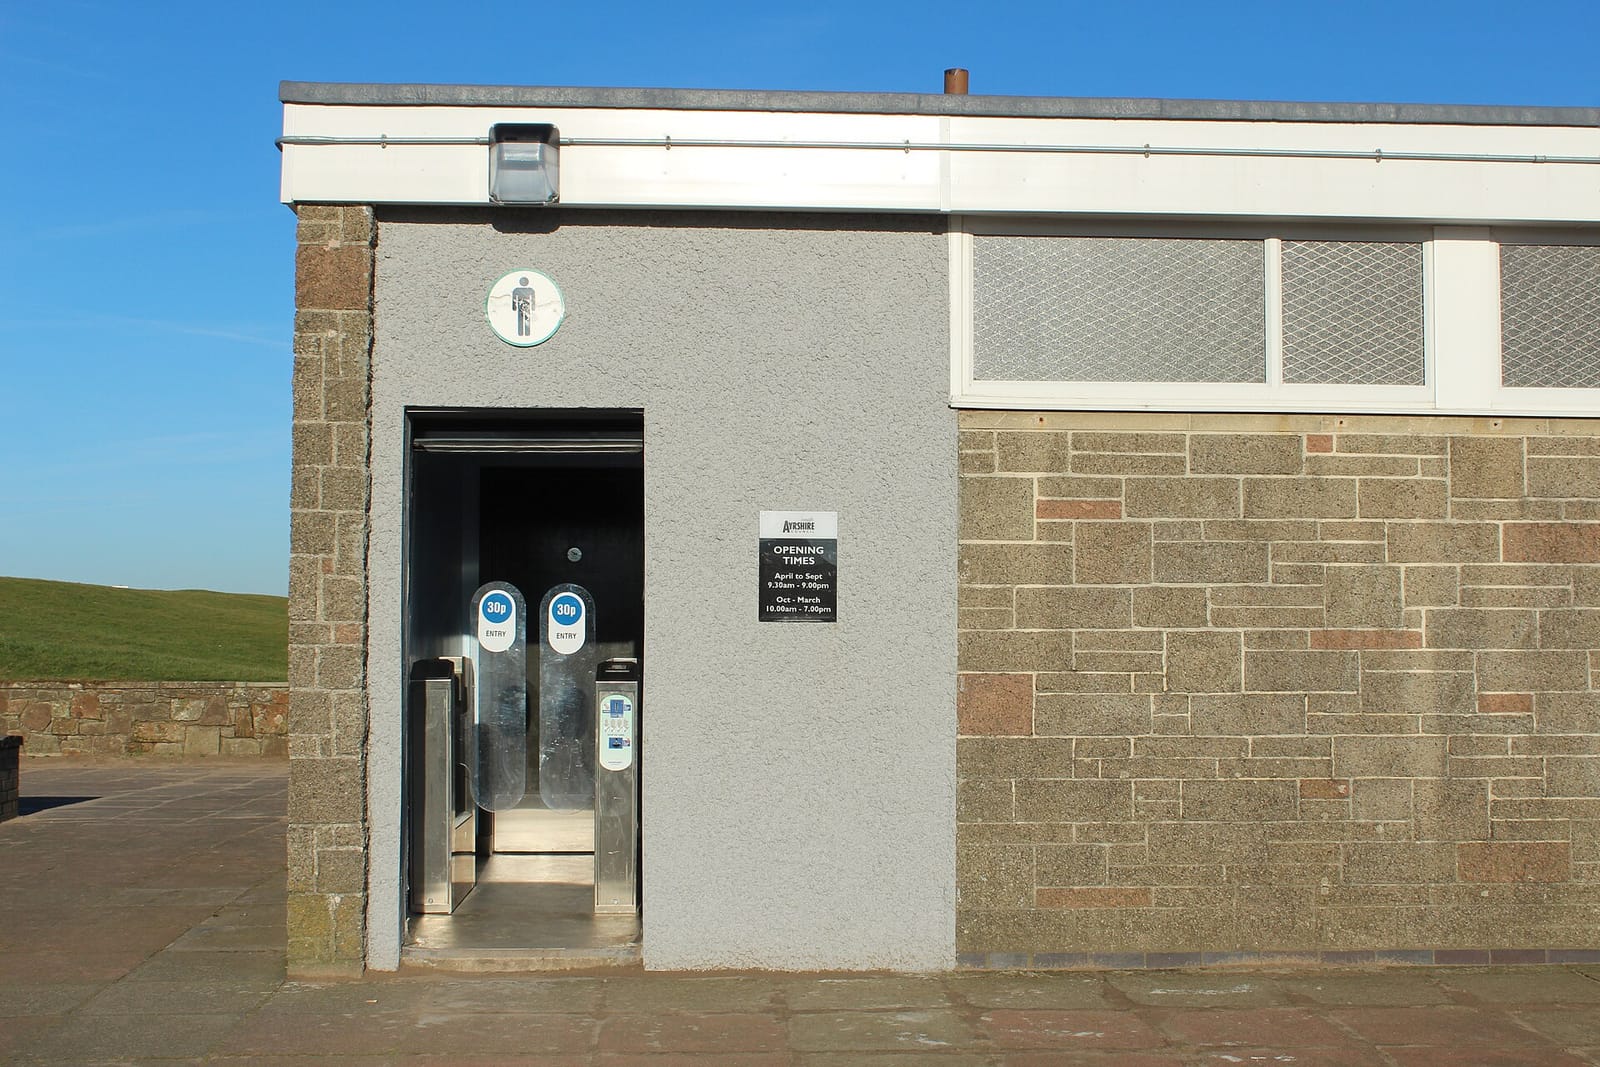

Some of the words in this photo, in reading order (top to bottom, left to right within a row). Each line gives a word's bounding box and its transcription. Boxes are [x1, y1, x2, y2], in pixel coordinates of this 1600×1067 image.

[783, 520, 815, 533] AYRSHIRE
[773, 546, 824, 555] OPENING
[783, 556, 815, 565] TIMES
[774, 572, 794, 581] April
[805, 572, 823, 581] Sept
[767, 581, 795, 589] 9.30am
[801, 582, 829, 590] 9.00pm
[487, 601, 507, 615] 30p
[557, 603, 576, 617] 30p
[766, 605, 797, 613] 10.00am
[803, 605, 831, 614] 7.00pm
[556, 632, 577, 640] ENTRY
